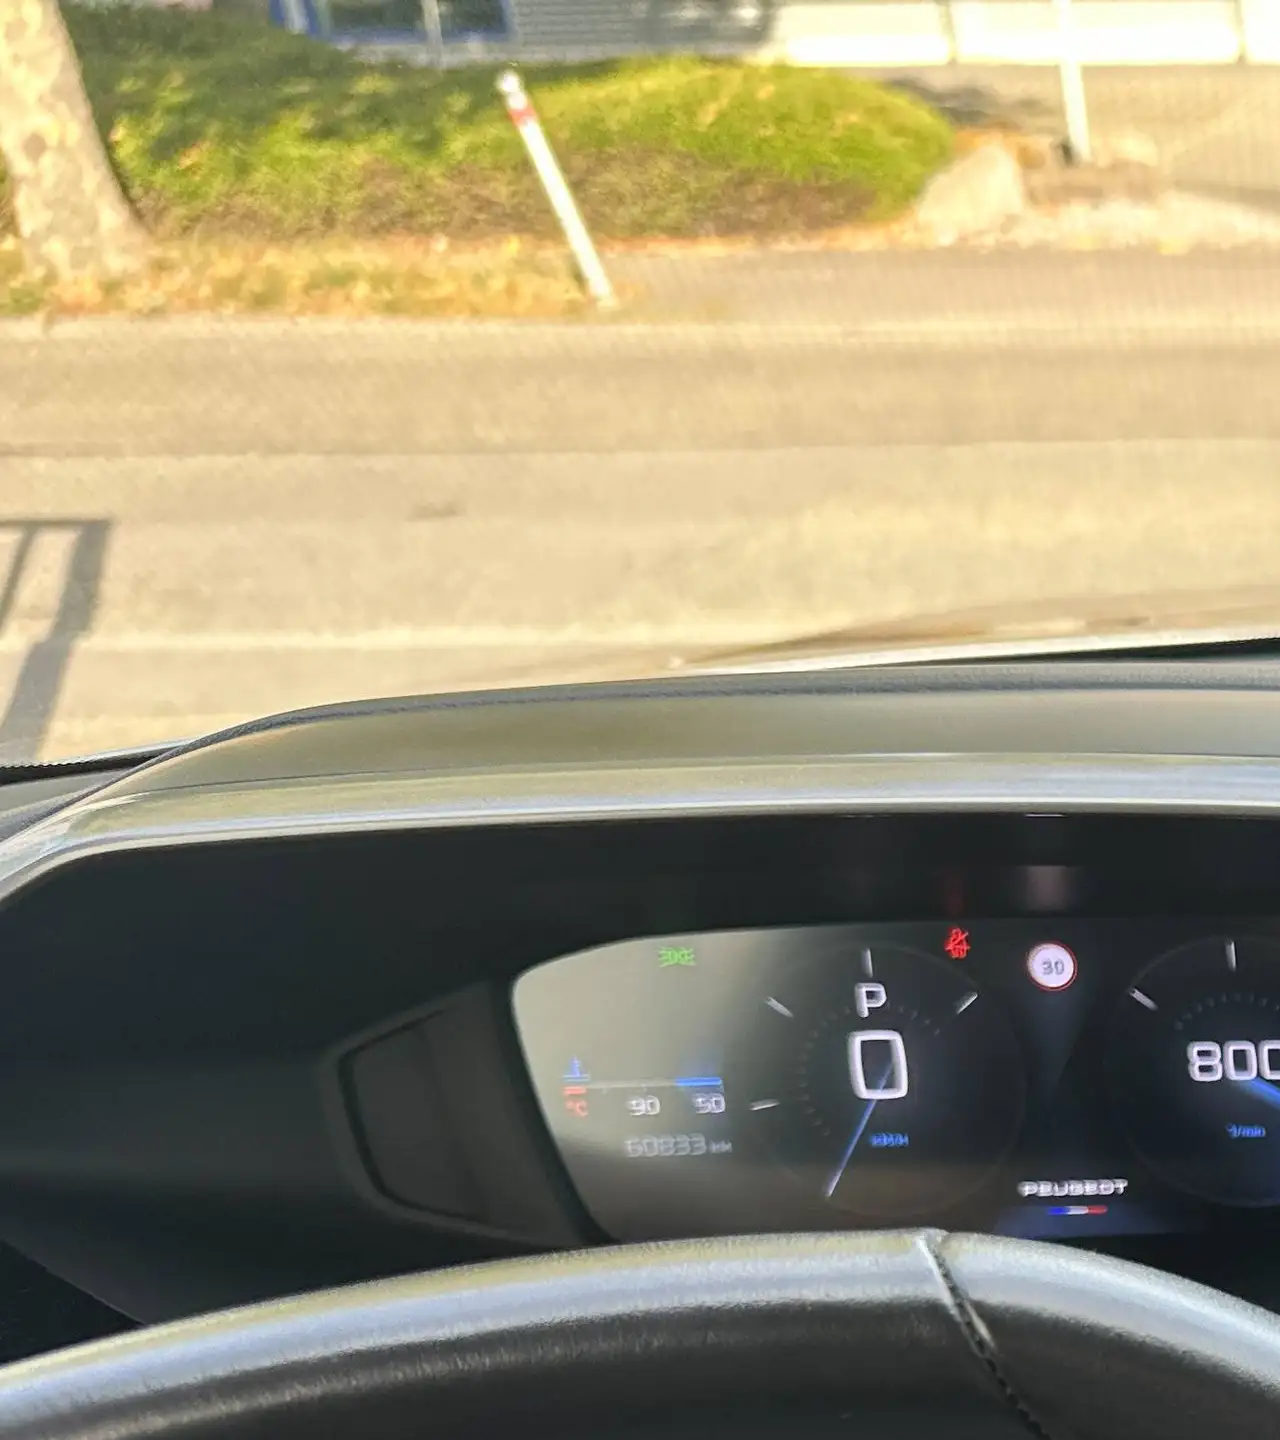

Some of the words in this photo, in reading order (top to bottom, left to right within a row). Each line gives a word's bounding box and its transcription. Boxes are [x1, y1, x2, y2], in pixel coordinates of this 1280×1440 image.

[1040, 957, 1066, 976] 30
[854, 982, 888, 1018] P
[847, 1029, 909, 1100] 0
[626, 1094, 661, 1116] 90
[691, 1092, 726, 1114] 50
[1017, 1178, 1129, 1198] PEUGEOT
